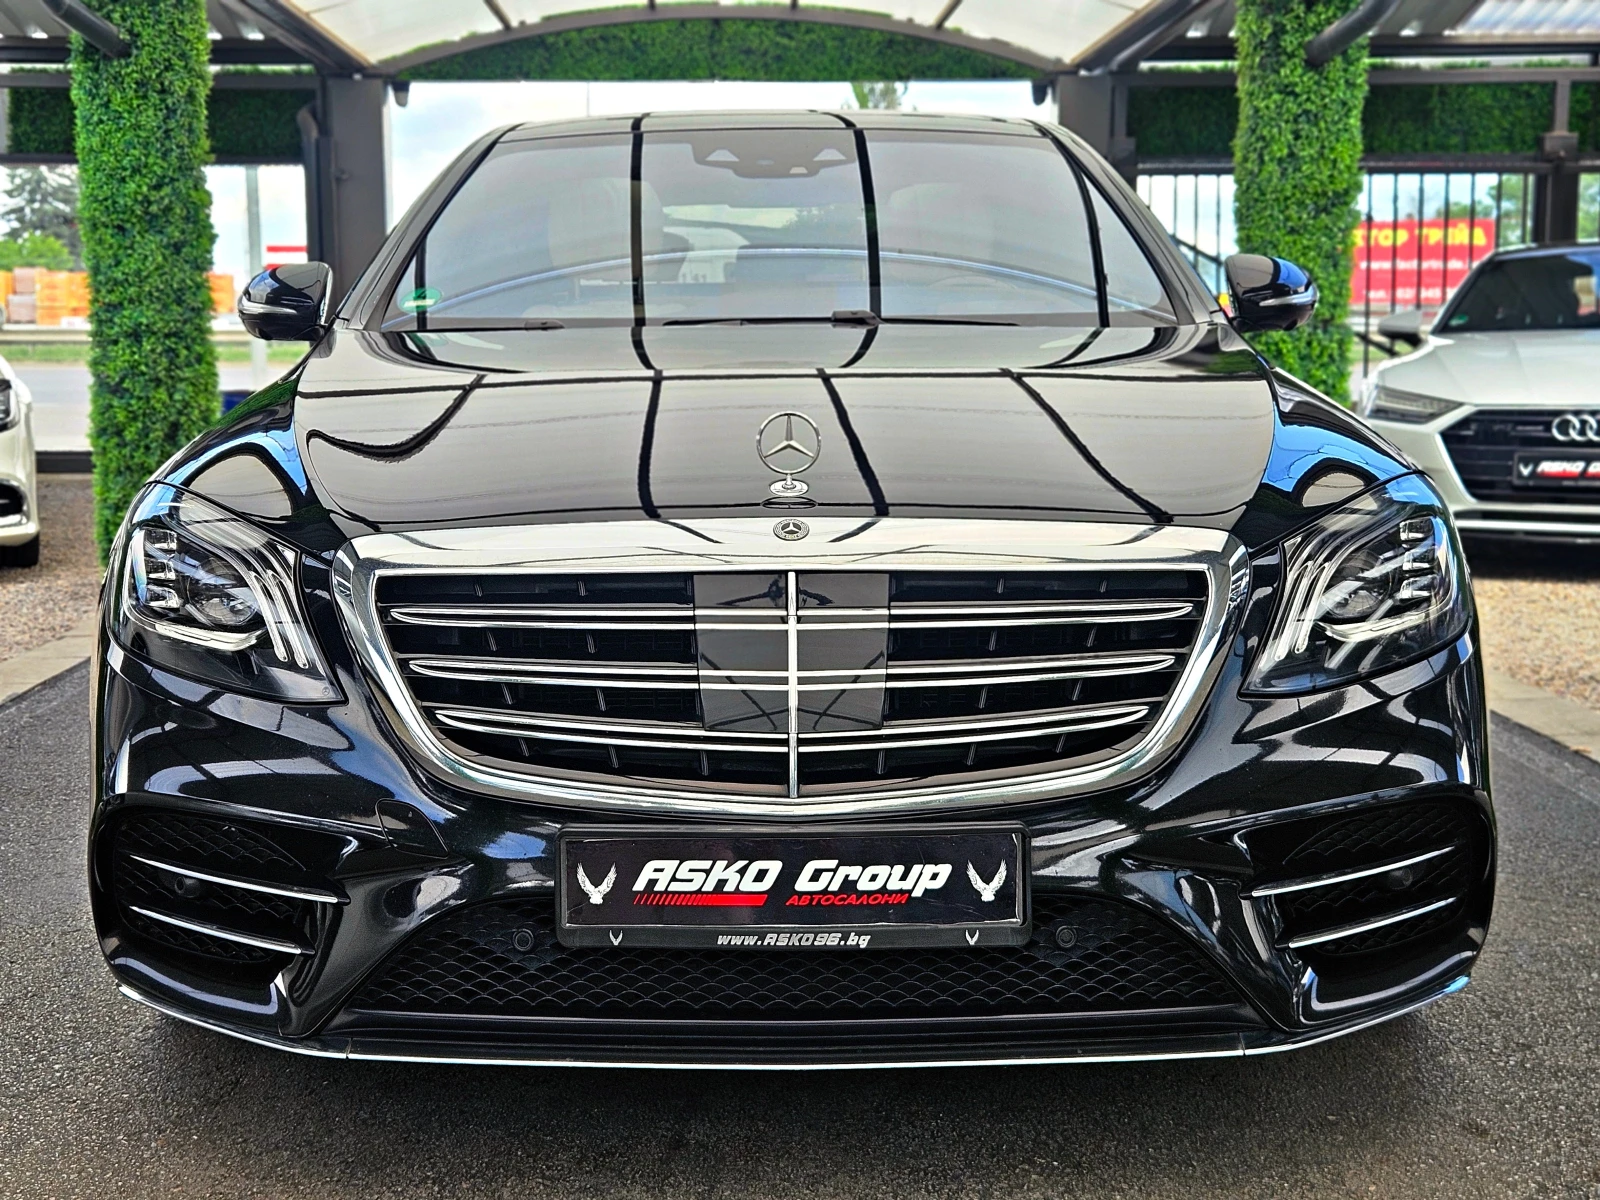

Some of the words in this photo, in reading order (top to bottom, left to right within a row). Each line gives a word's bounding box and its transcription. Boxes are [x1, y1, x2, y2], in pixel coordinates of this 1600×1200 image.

[632, 859, 783, 892] ASKO
[794, 859, 953, 898] Group
[785, 893, 910, 906] АВТОСАЛОНИ
[717, 932, 872, 949] www.ASKO96.bg
